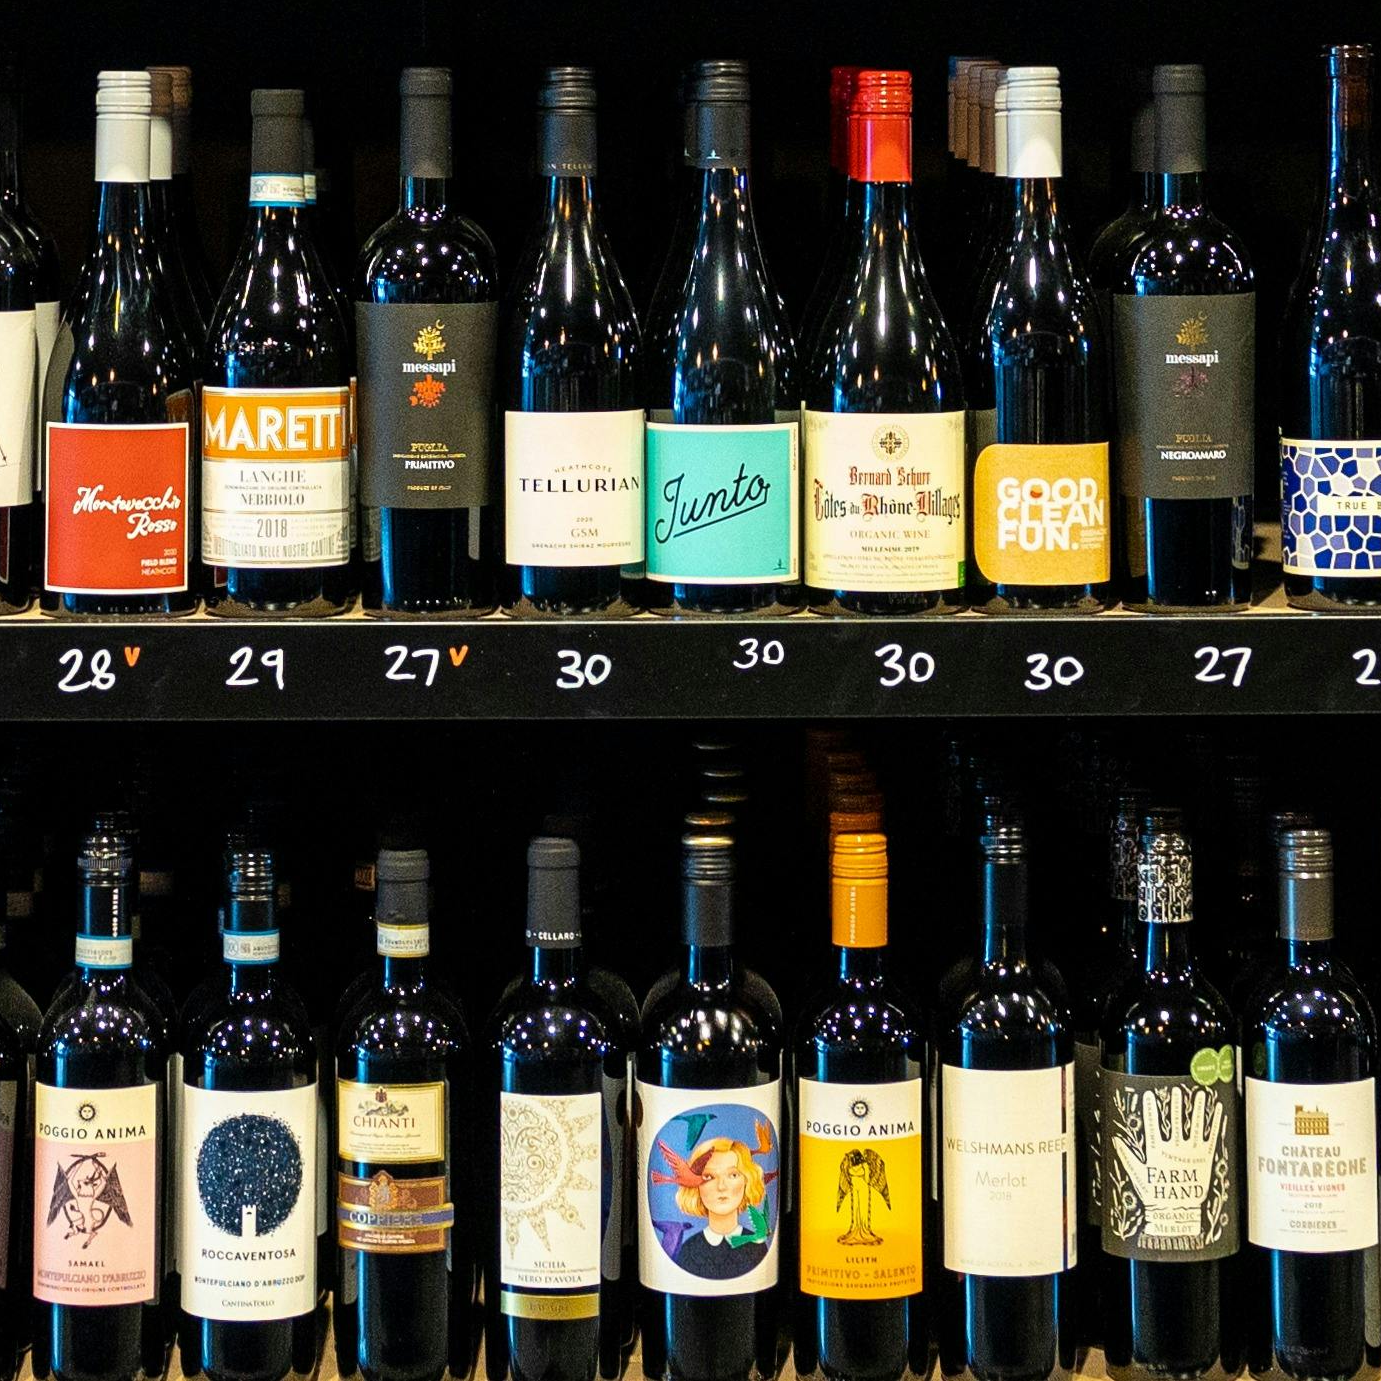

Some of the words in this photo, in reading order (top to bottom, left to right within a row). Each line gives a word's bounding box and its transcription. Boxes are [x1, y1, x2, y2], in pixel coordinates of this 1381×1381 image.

[403, 359, 456, 376] messapi
[1160, 451, 1226, 461] NEGROAMARO
[240, 470, 306, 482] LANGHE
[519, 476, 640, 494] TELLURIAN
[241, 493, 304, 507] NEBBIOLO
[655, 463, 771, 544] Junto
[998, 478, 1097, 505] GOOD
[998, 502, 1104, 526] CLEAN
[1337, 501, 1370, 511] TRUE
[126, 513, 176, 540] Rosso
[998, 523, 1078, 551] FUN.
[732, 637, 785, 670] 30
[874, 643, 935, 687] 30
[57, 648, 116, 693] 28
[225, 646, 285, 691] 29
[384, 645, 440, 687] 27
[556, 649, 612, 689] 30
[1023, 652, 1085, 691] 30
[1194, 646, 1252, 688] 27
[39, 1124, 87, 1140] POGGIO
[95, 1124, 146, 1139] ANIMA
[354, 1116, 415, 1129] CHIANTI
[806, 1120, 861, 1136] POGGIO
[868, 1121, 914, 1136] ANIMA
[1146, 1165, 1199, 1184] FARM
[1154, 1183, 1203, 1200] HAND
[201, 1248, 296, 1261] ROCCAVENTOSA
